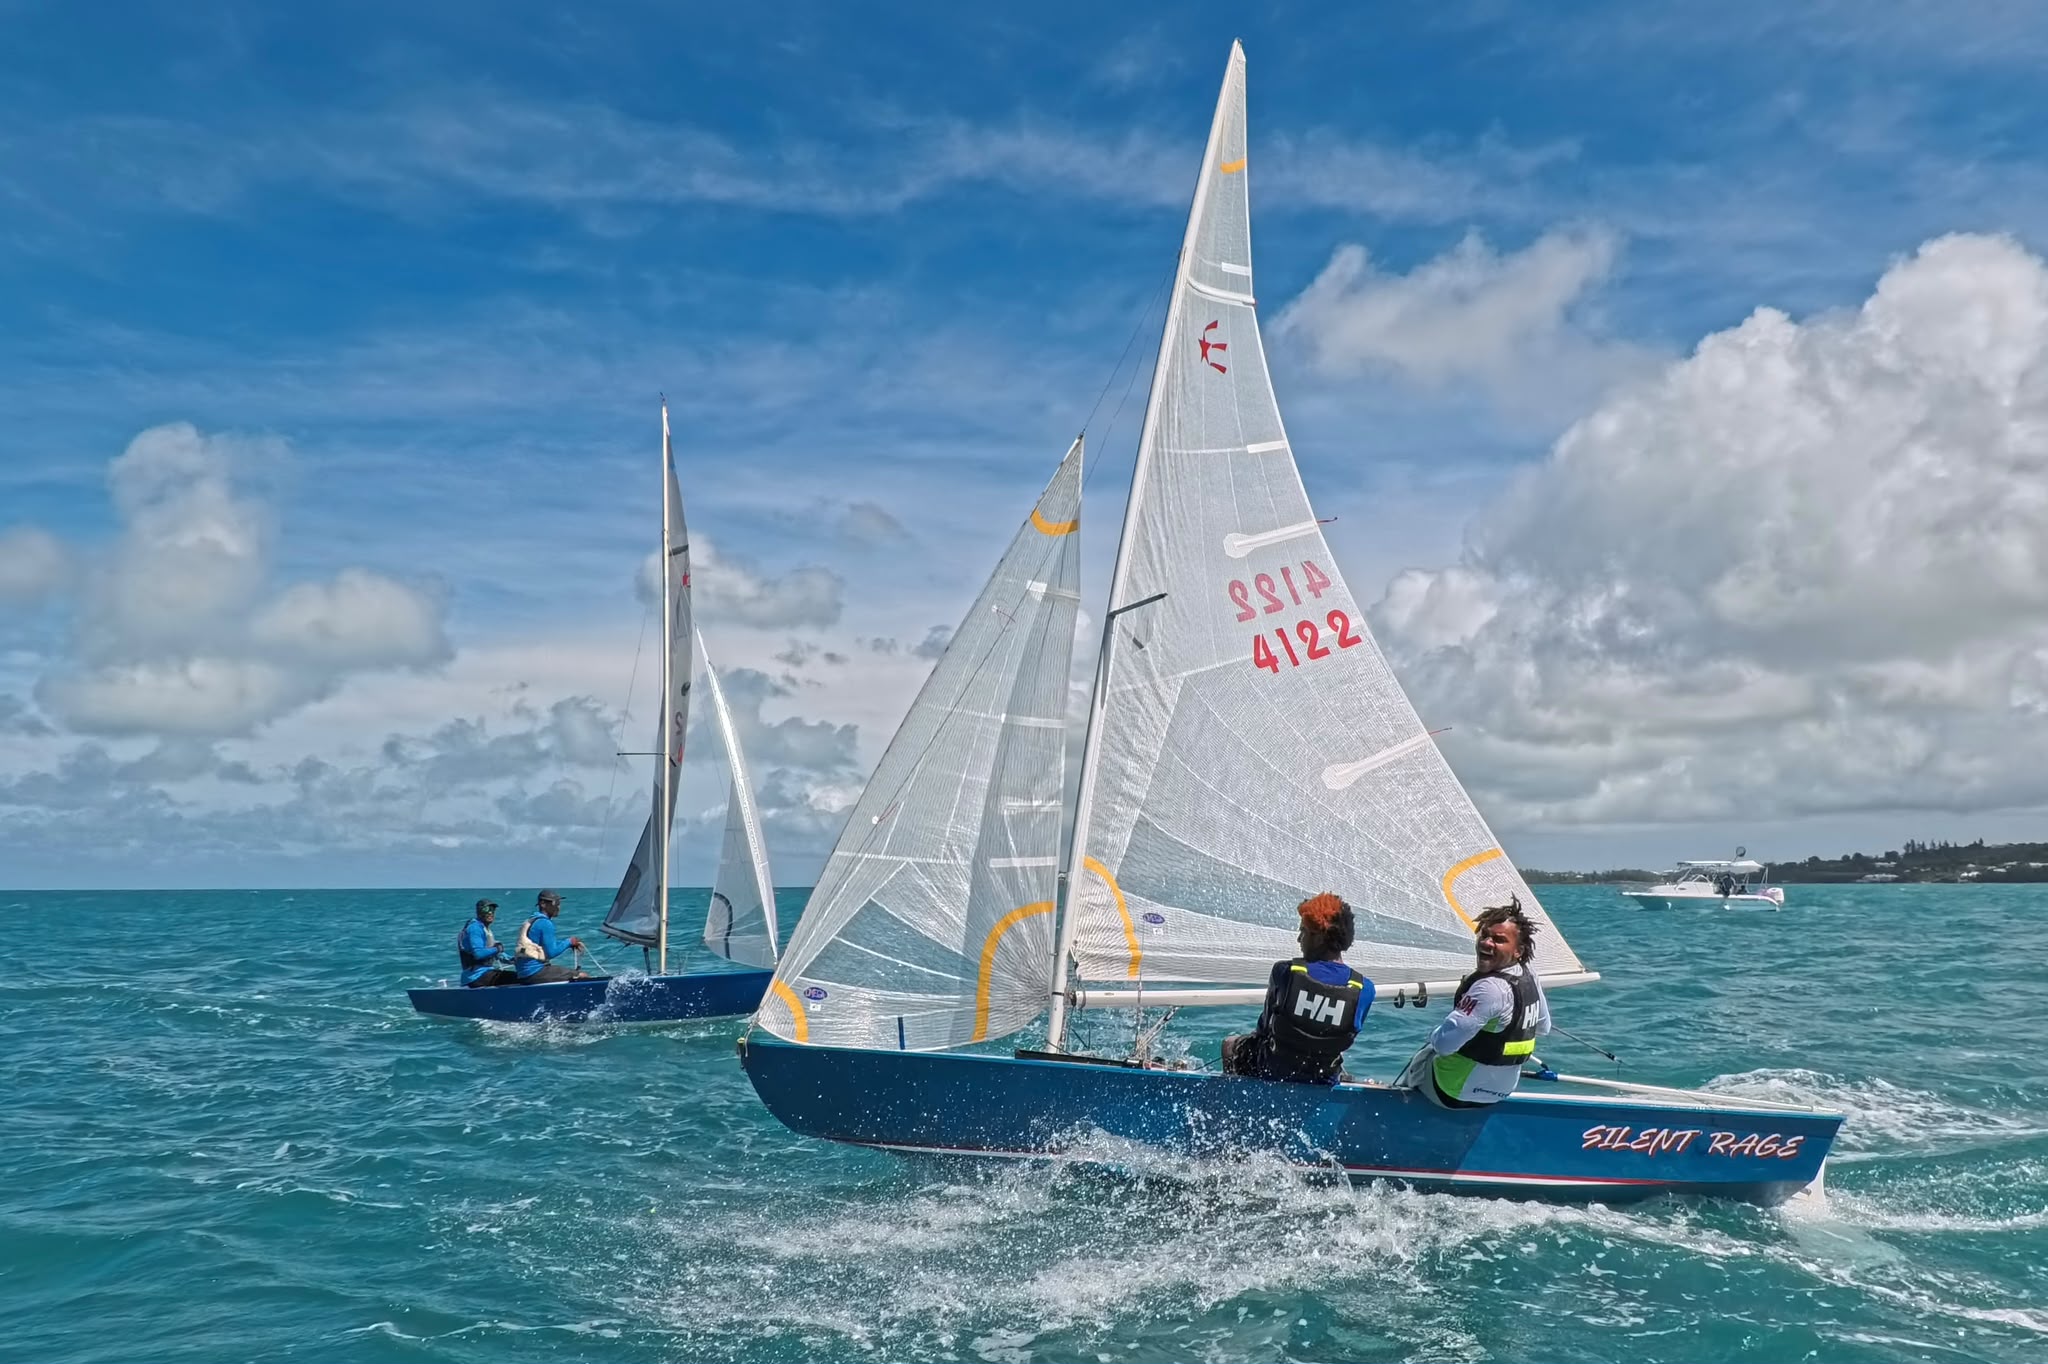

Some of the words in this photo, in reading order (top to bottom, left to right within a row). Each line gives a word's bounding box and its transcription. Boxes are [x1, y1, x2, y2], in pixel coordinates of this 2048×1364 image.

[1253, 609, 1362, 674] 4122
[1294, 990, 1345, 1026] HH
[1581, 1124, 1702, 1158] SILENT
[1707, 1131, 1805, 1159] RAGE
